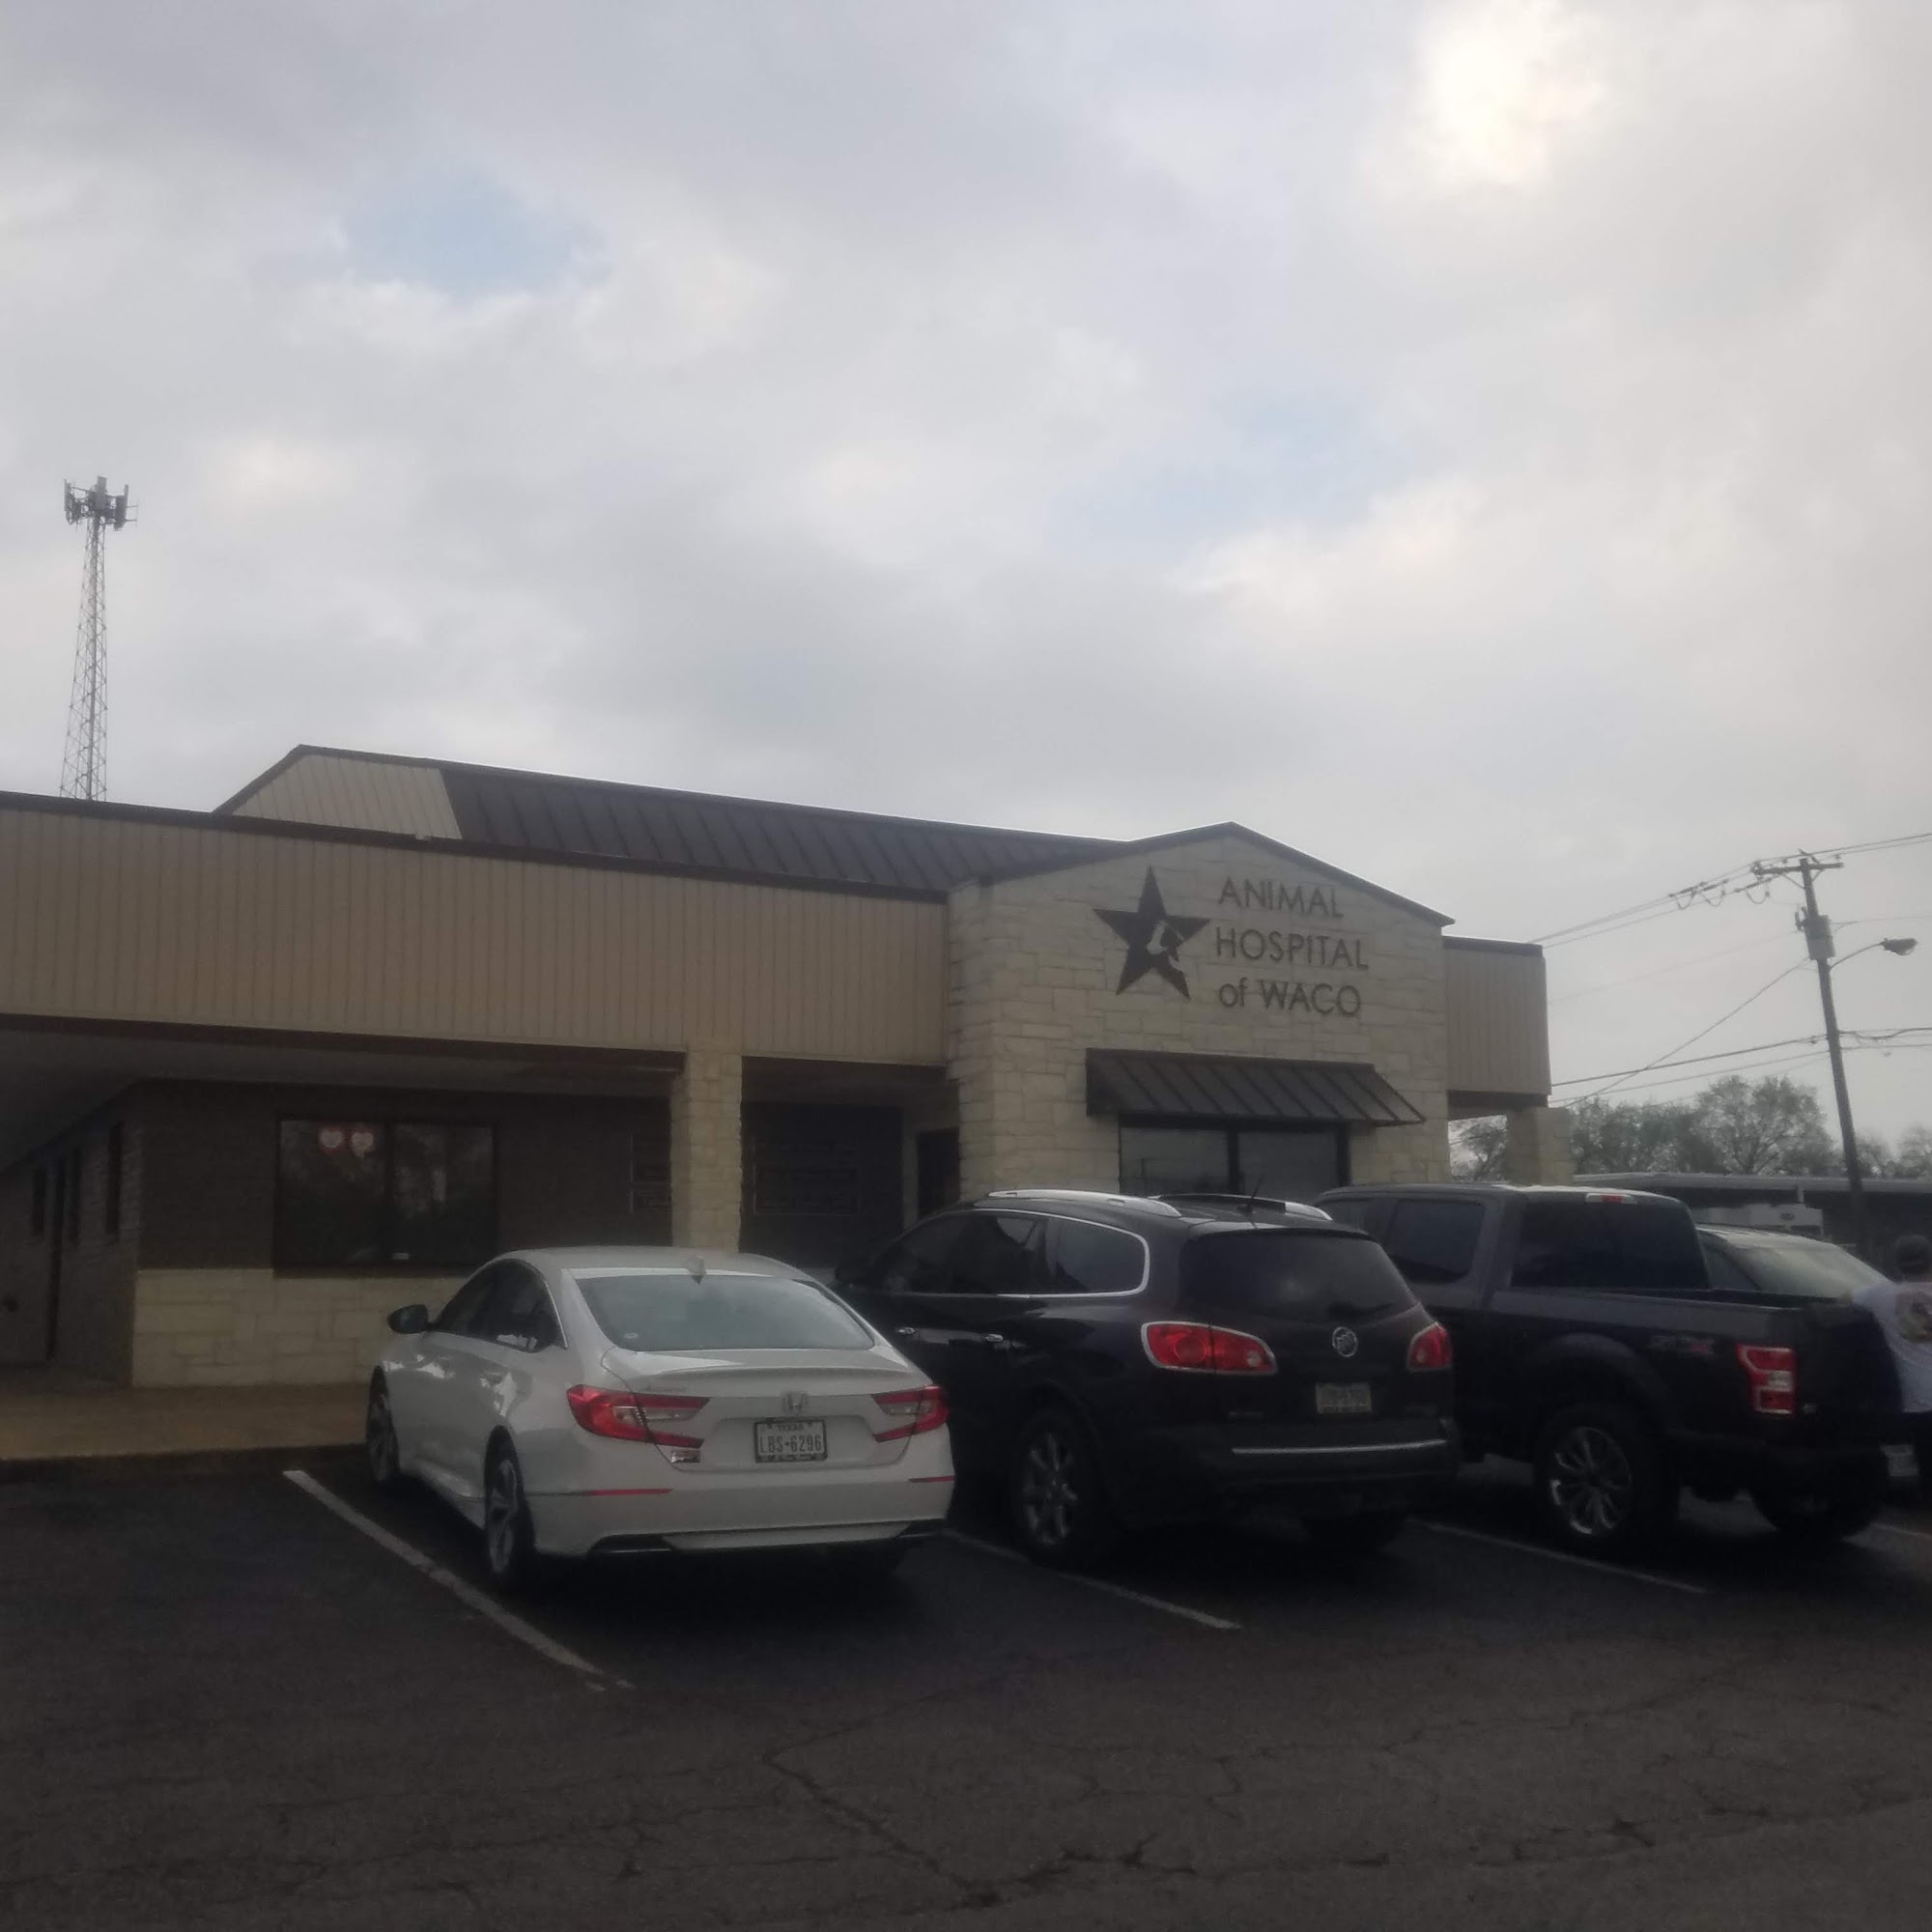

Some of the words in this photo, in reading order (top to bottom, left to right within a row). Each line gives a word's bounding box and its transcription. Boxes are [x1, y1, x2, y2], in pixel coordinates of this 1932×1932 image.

[1218, 875, 1344, 919] ANIMAL
[1215, 926, 1370, 971] HOSPITAL
[1219, 977, 1248, 1008] of
[1259, 979, 1361, 1017] WACO
